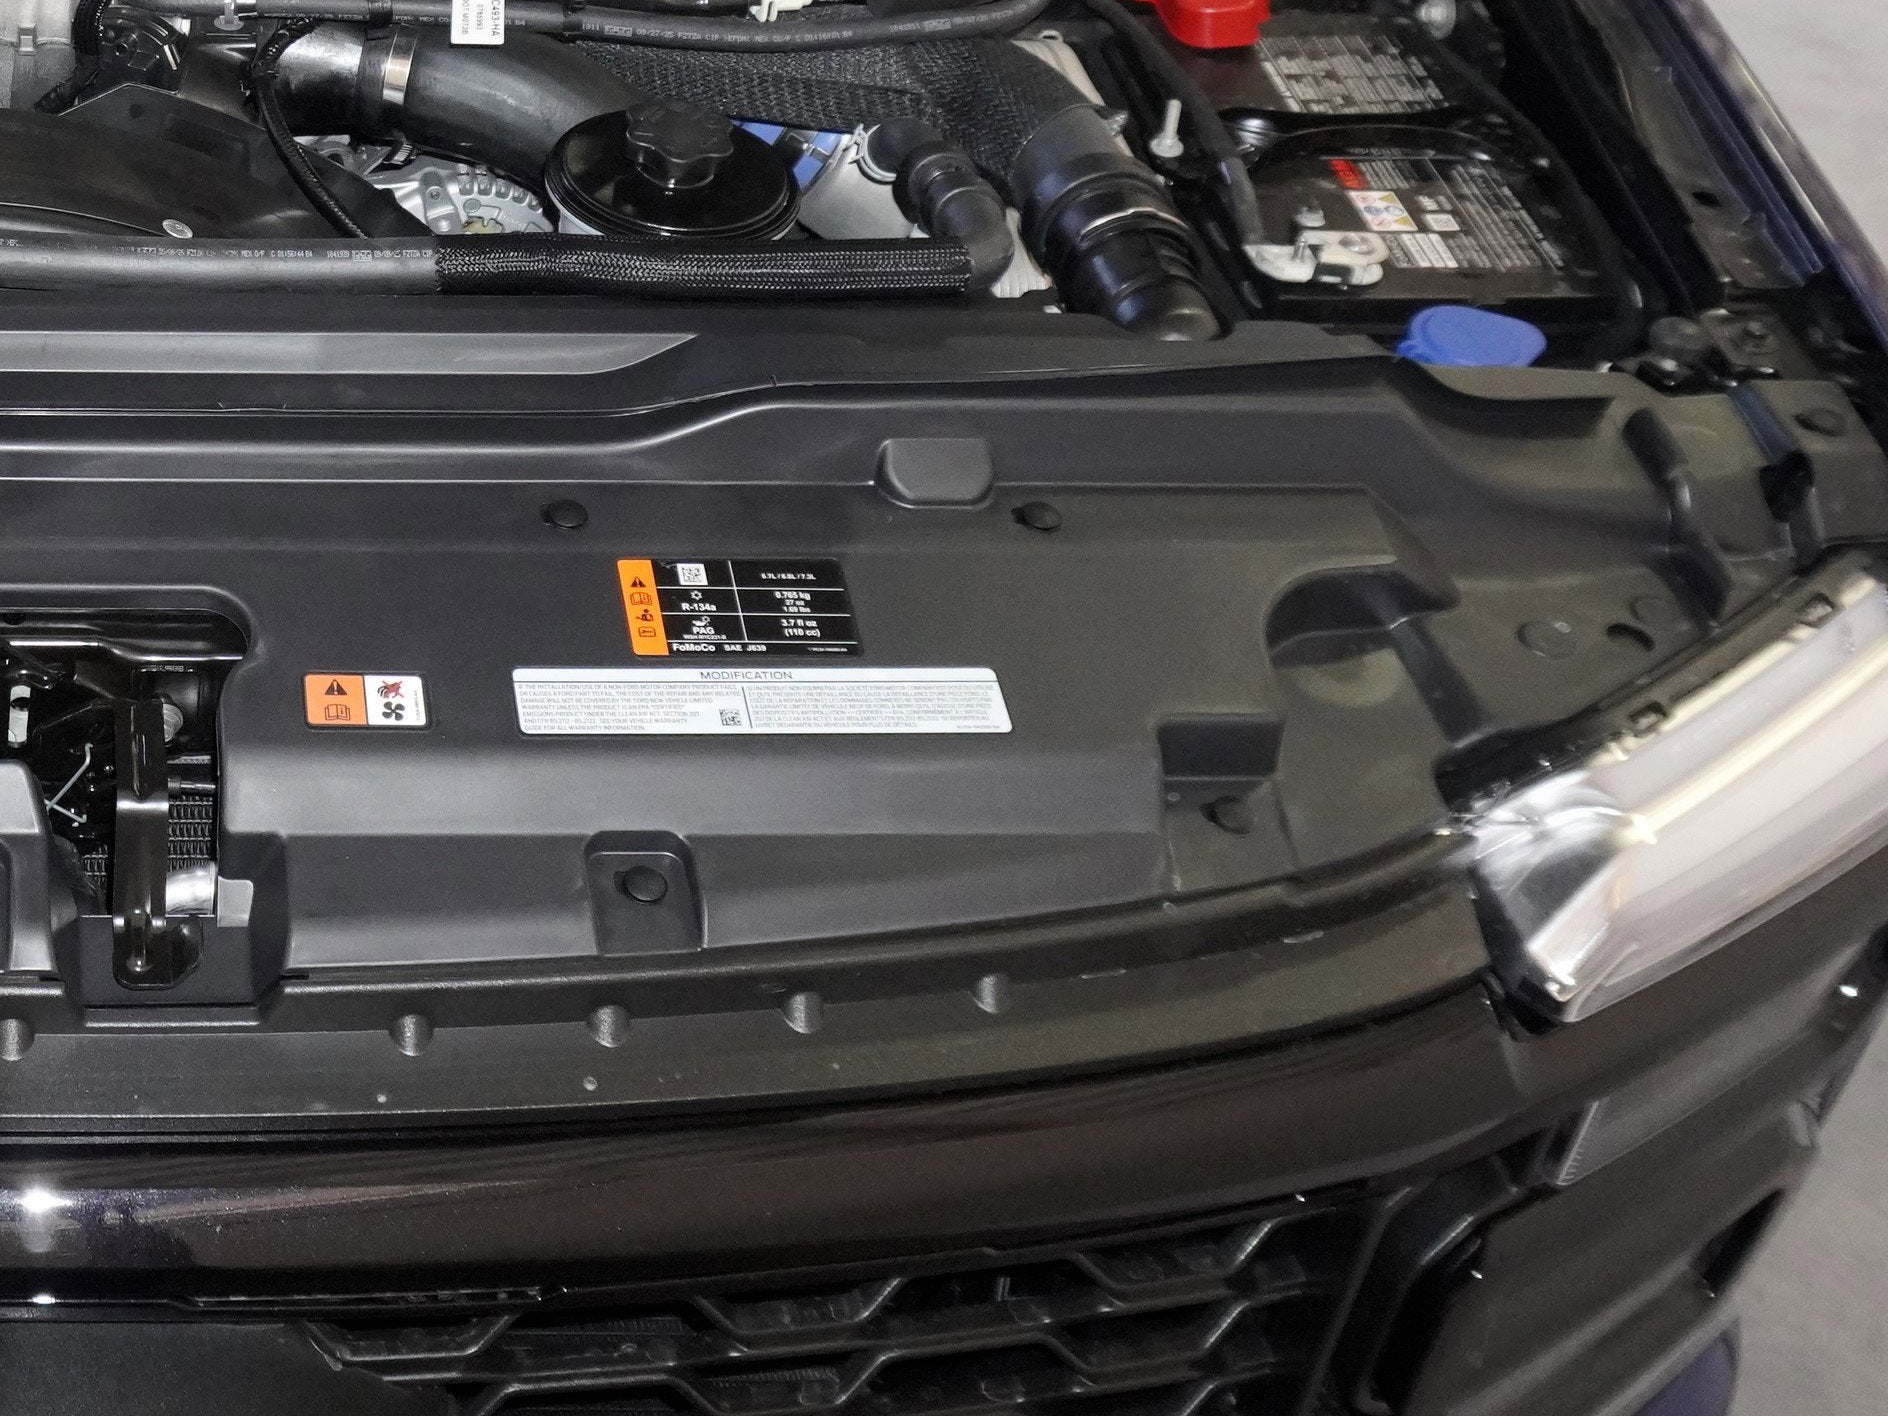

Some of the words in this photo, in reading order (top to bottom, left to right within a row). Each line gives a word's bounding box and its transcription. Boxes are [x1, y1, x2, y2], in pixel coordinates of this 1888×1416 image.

[774, 591, 799, 599] 0.765
[799, 592, 811, 600] kg
[681, 602, 717, 611] R-134a
[781, 619, 795, 627] 3.7
[692, 627, 715, 635] PAG
[784, 628, 804, 637] (110
[805, 629, 821, 637] cc)
[672, 643, 716, 652] FoMoCo
[723, 644, 743, 652] SAE
[746, 644, 767, 652] J639
[700, 671, 793, 680] MODIFICATION
